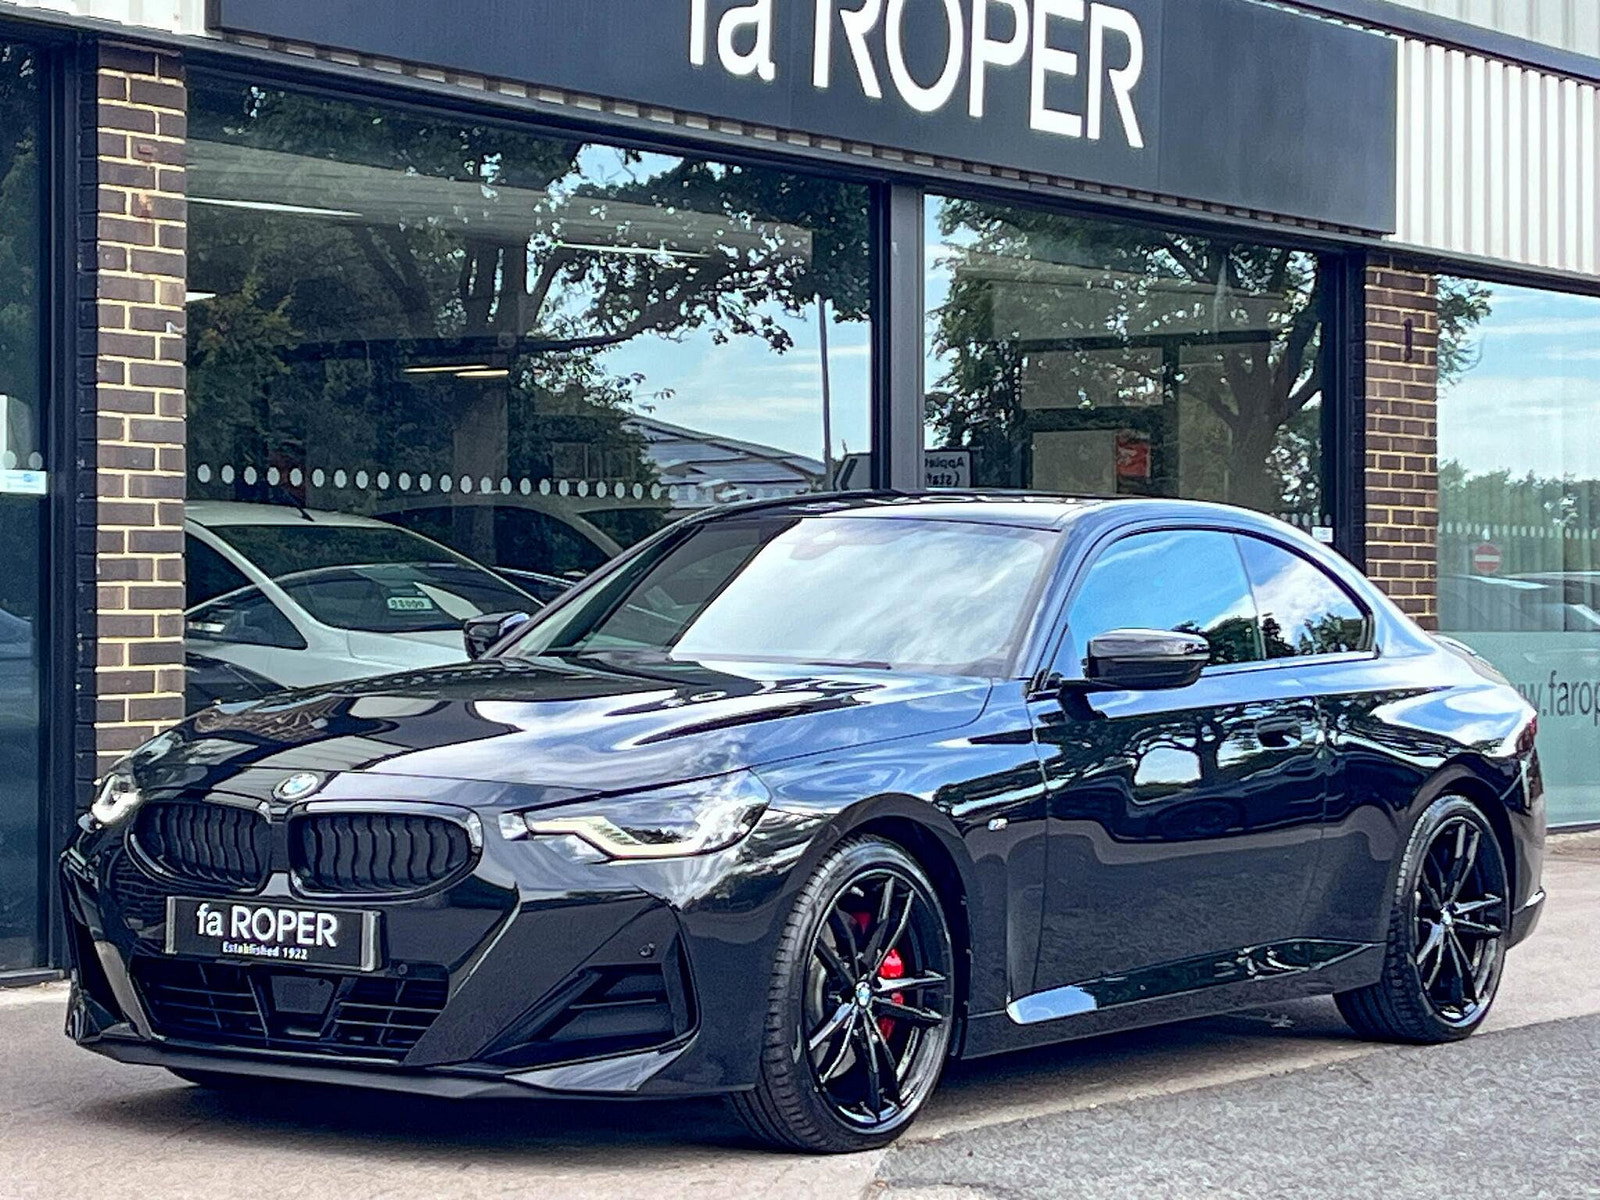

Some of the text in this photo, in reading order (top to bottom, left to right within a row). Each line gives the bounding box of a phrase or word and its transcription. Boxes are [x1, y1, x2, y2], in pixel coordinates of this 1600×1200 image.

[813, 0, 1144, 149] ROPER
[197, 903, 338, 947] fa ROPER
[222, 941, 308, 960] Established 1922
